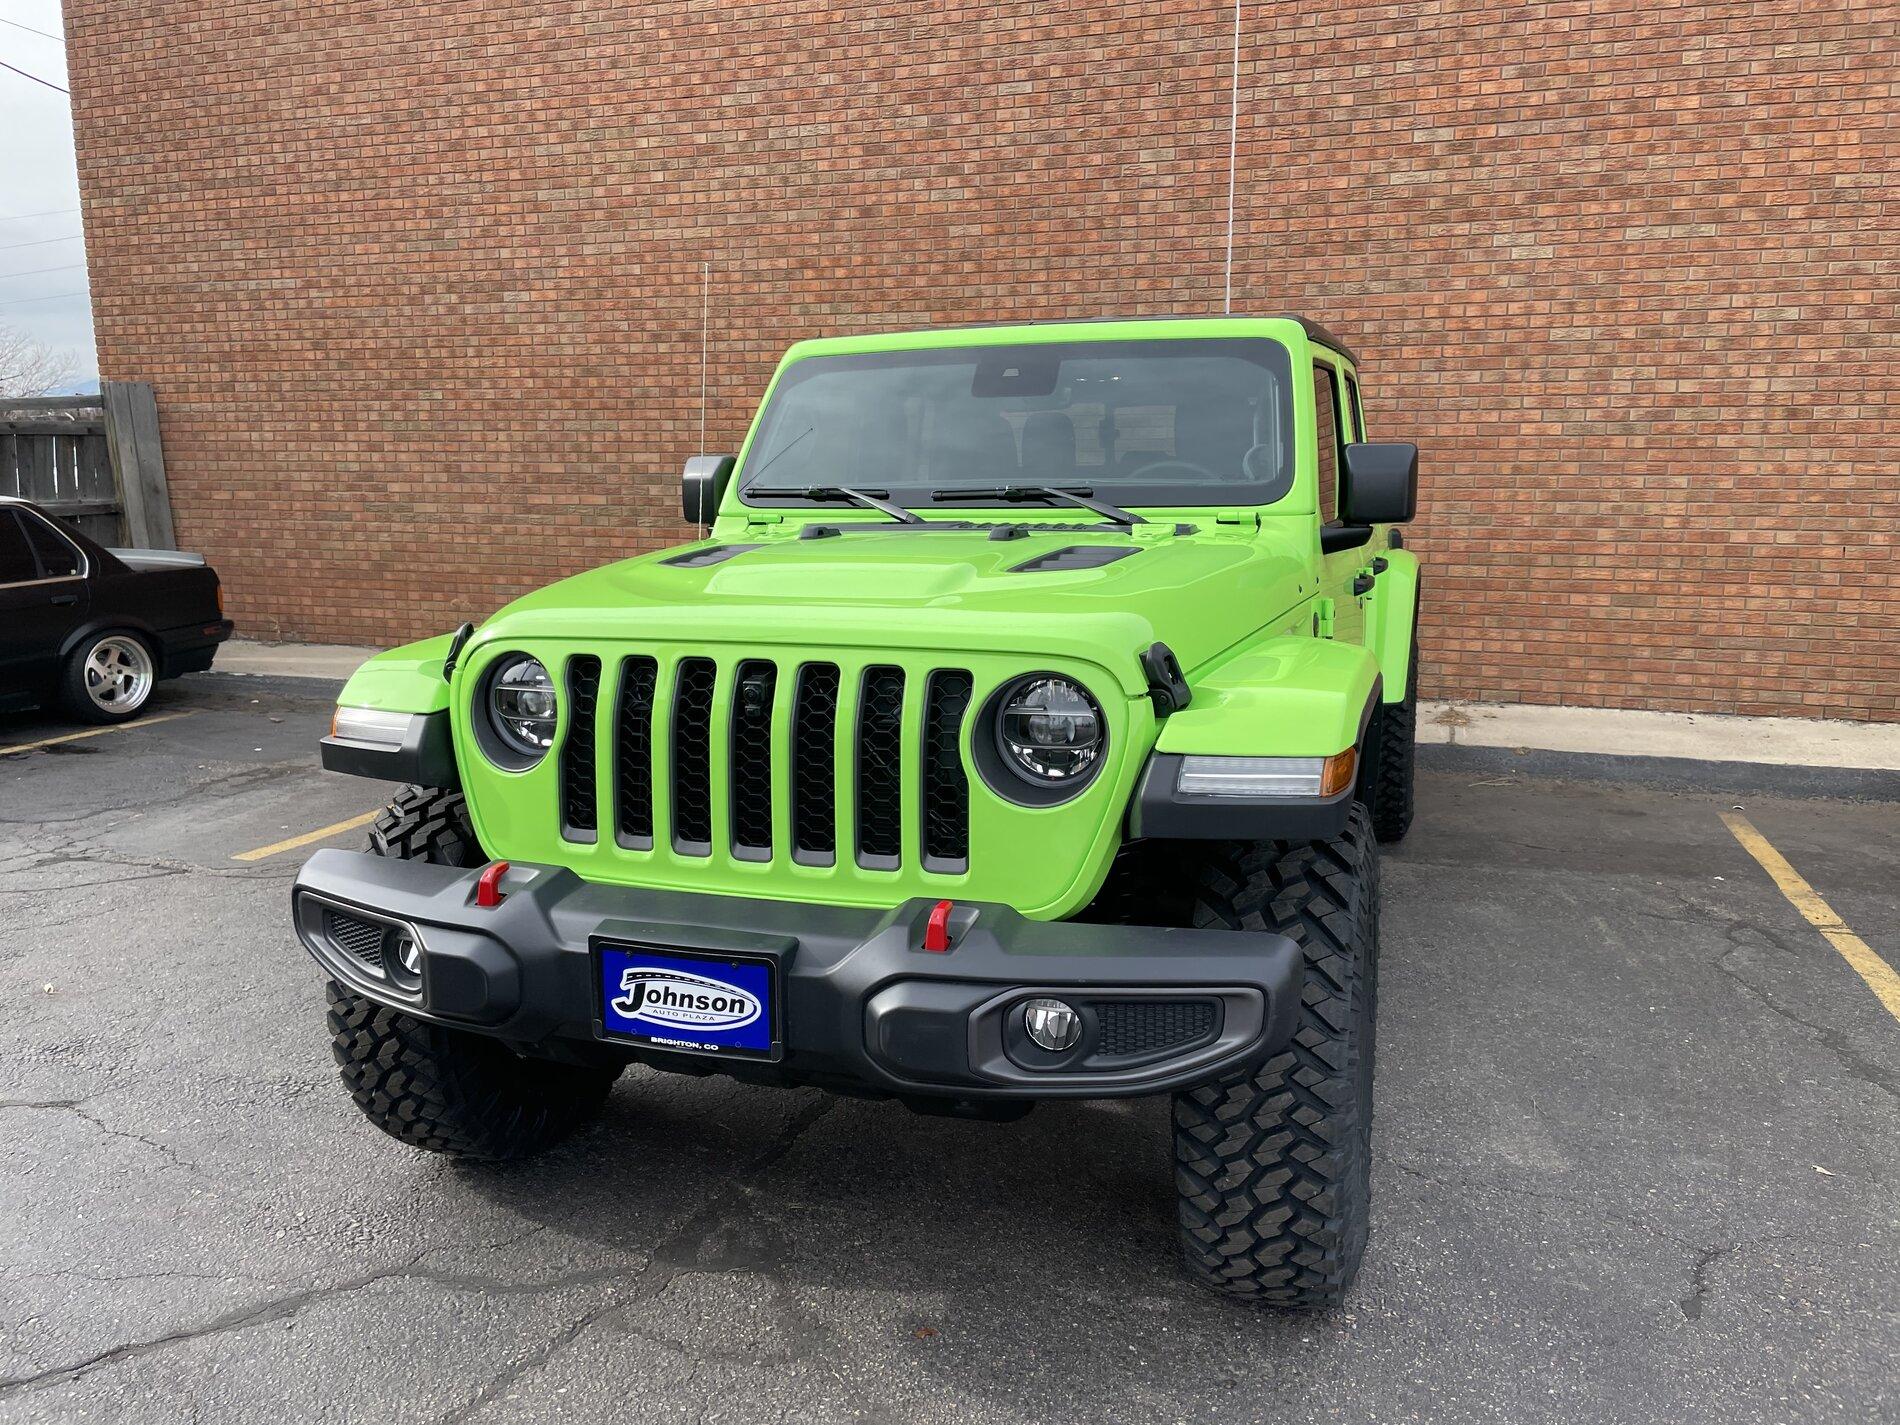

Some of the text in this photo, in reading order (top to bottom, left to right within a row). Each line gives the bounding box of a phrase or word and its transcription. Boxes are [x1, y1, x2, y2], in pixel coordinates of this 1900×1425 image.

[615, 982, 745, 1014] Johnson
[652, 1009, 716, 1022] AUTO PLAZA
[650, 1036, 702, 1049] BRIGHTON,
[703, 1043, 719, 1051] CO
